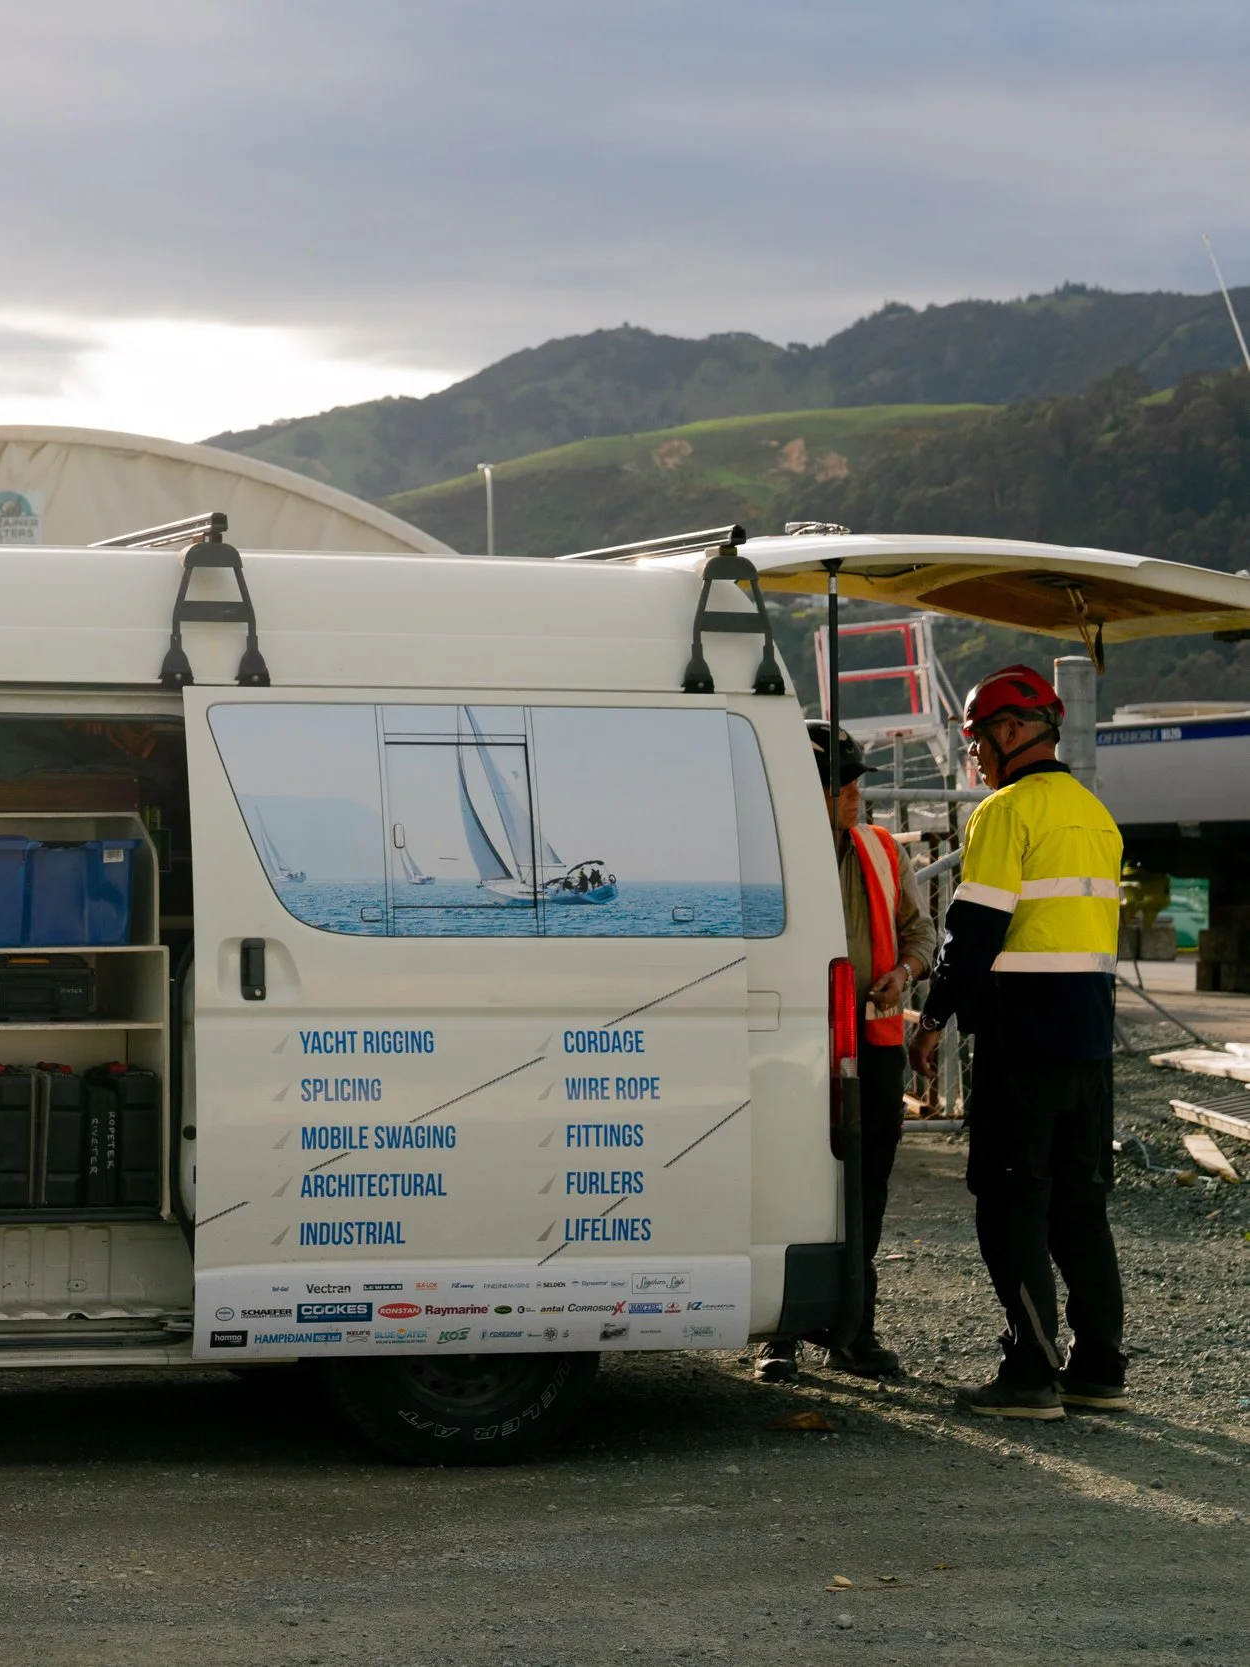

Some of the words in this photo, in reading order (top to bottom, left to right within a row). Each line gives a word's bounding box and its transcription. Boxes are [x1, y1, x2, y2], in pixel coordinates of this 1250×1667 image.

[300, 1030, 358, 1054] YACHT
[363, 1030, 435, 1054] RIGGING
[563, 1030, 645, 1053] CORDAGE
[301, 1078, 382, 1102] SPLICING
[565, 1077, 611, 1100] WIRE
[616, 1077, 661, 1100] ROPE
[89, 1118, 99, 1175] RIVETER
[106, 1111, 116, 1169] ROPETEK
[301, 1126, 369, 1150] MOBILE
[374, 1125, 457, 1149] SWAGING
[566, 1124, 644, 1147] FITTINGS
[300, 1173, 448, 1198] ARCHITECTURAL
[566, 1171, 644, 1195] FURLERS
[299, 1221, 406, 1246] INDUSTRIAL
[564, 1218, 652, 1242] LIFELINES
[306, 1284, 351, 1294] Vectran
[301, 1304, 368, 1315] COOKES
[425, 1304, 488, 1316] Raymarine
[686, 1302, 703, 1310] KZ
